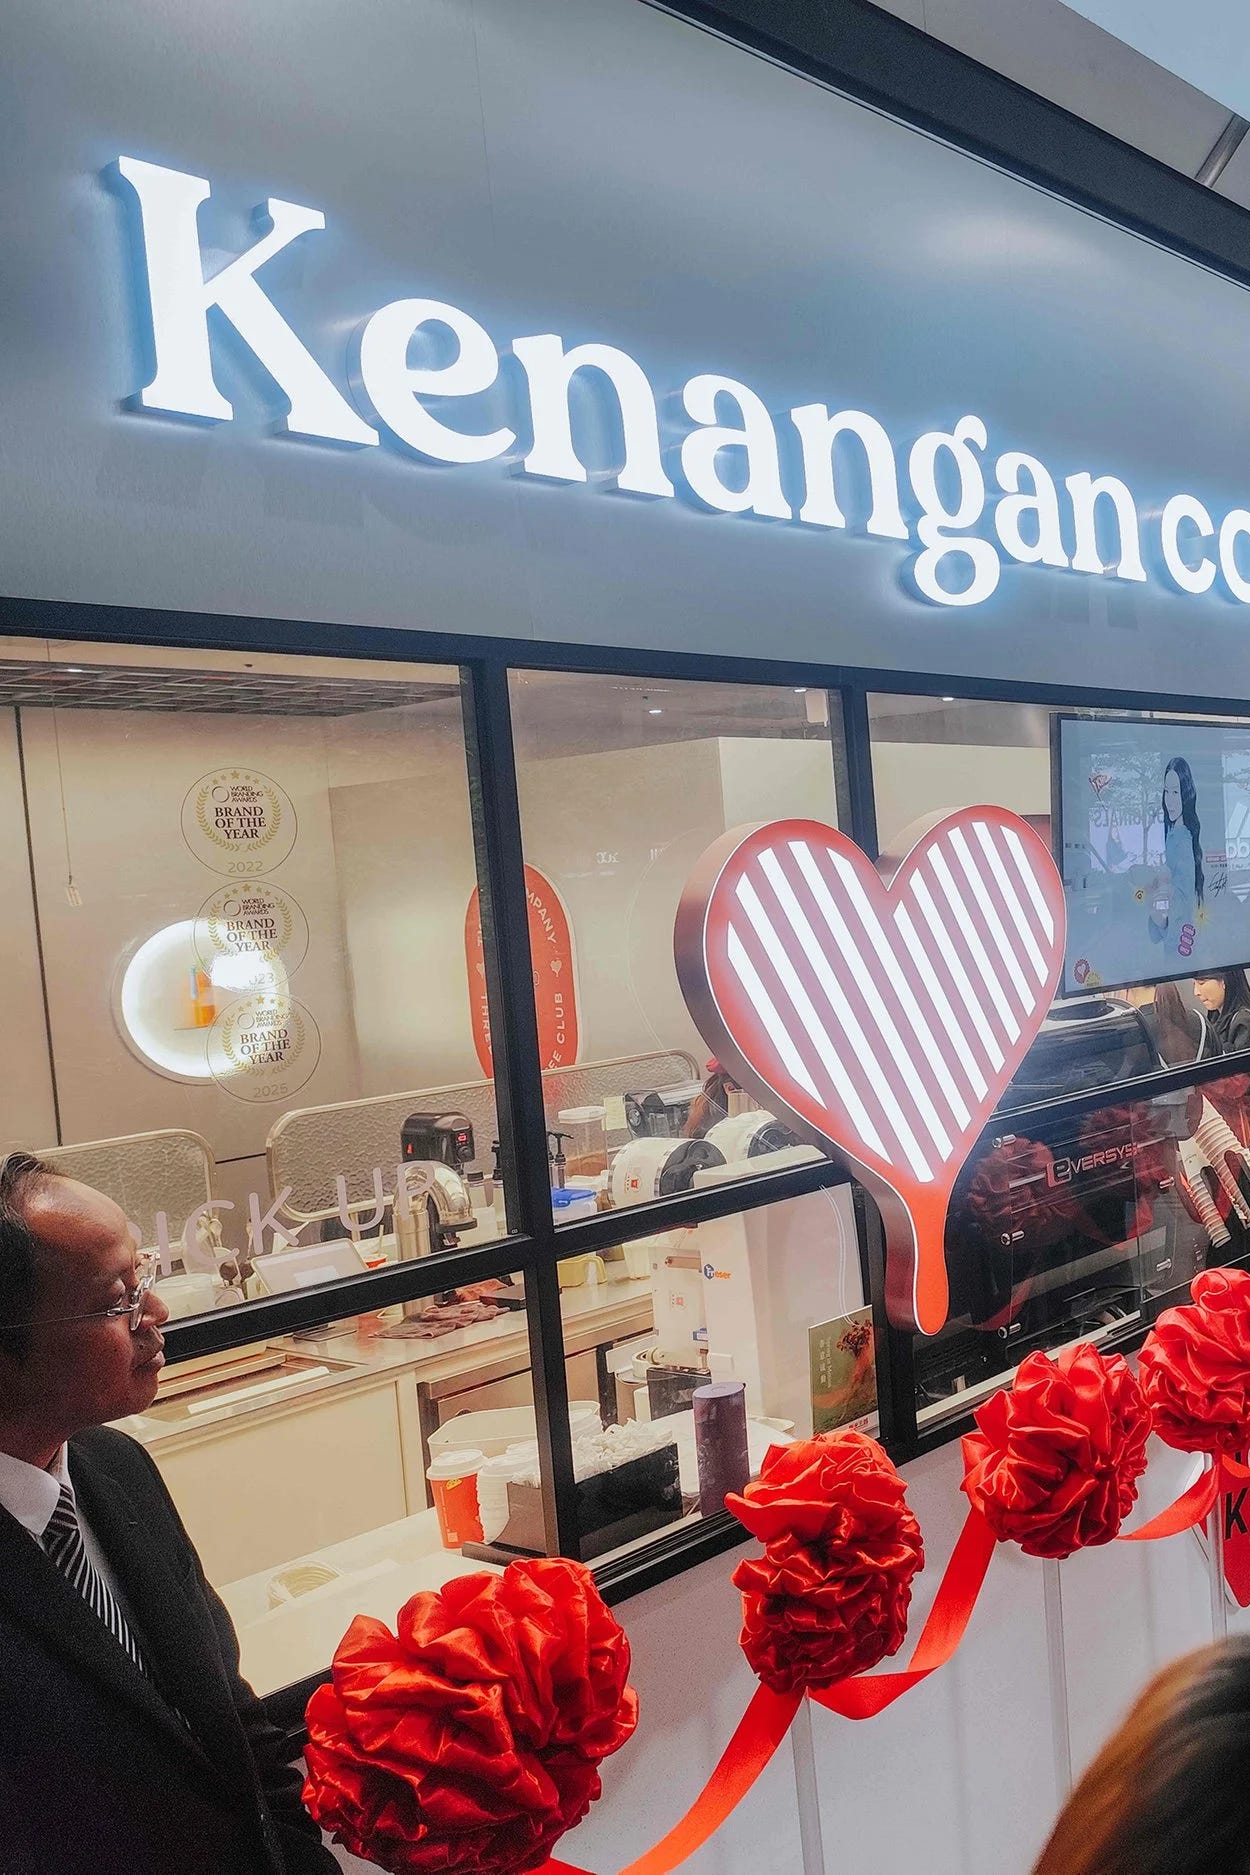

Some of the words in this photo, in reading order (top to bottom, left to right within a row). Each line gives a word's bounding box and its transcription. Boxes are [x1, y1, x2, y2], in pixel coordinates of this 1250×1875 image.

[118, 156, 1146, 606] Kenangan
[214, 806, 264, 818] BRAND
[214, 818, 235, 830] OF
[236, 816, 267, 829] THE
[224, 828, 260, 840] YEAR
[227, 860, 264, 873] 2022
[226, 918, 275, 932] BRAND
[226, 931, 247, 943] OF
[248, 928, 278, 941] THE
[234, 940, 271, 953] YEAR
[553, 991, 566, 1045] CLUB
[240, 1028, 288, 1045] BRAND
[240, 1043, 260, 1056] OF
[260, 1038, 292, 1053] THE
[249, 1051, 285, 1065] YEAR
[336, 1160, 434, 1232] UP
